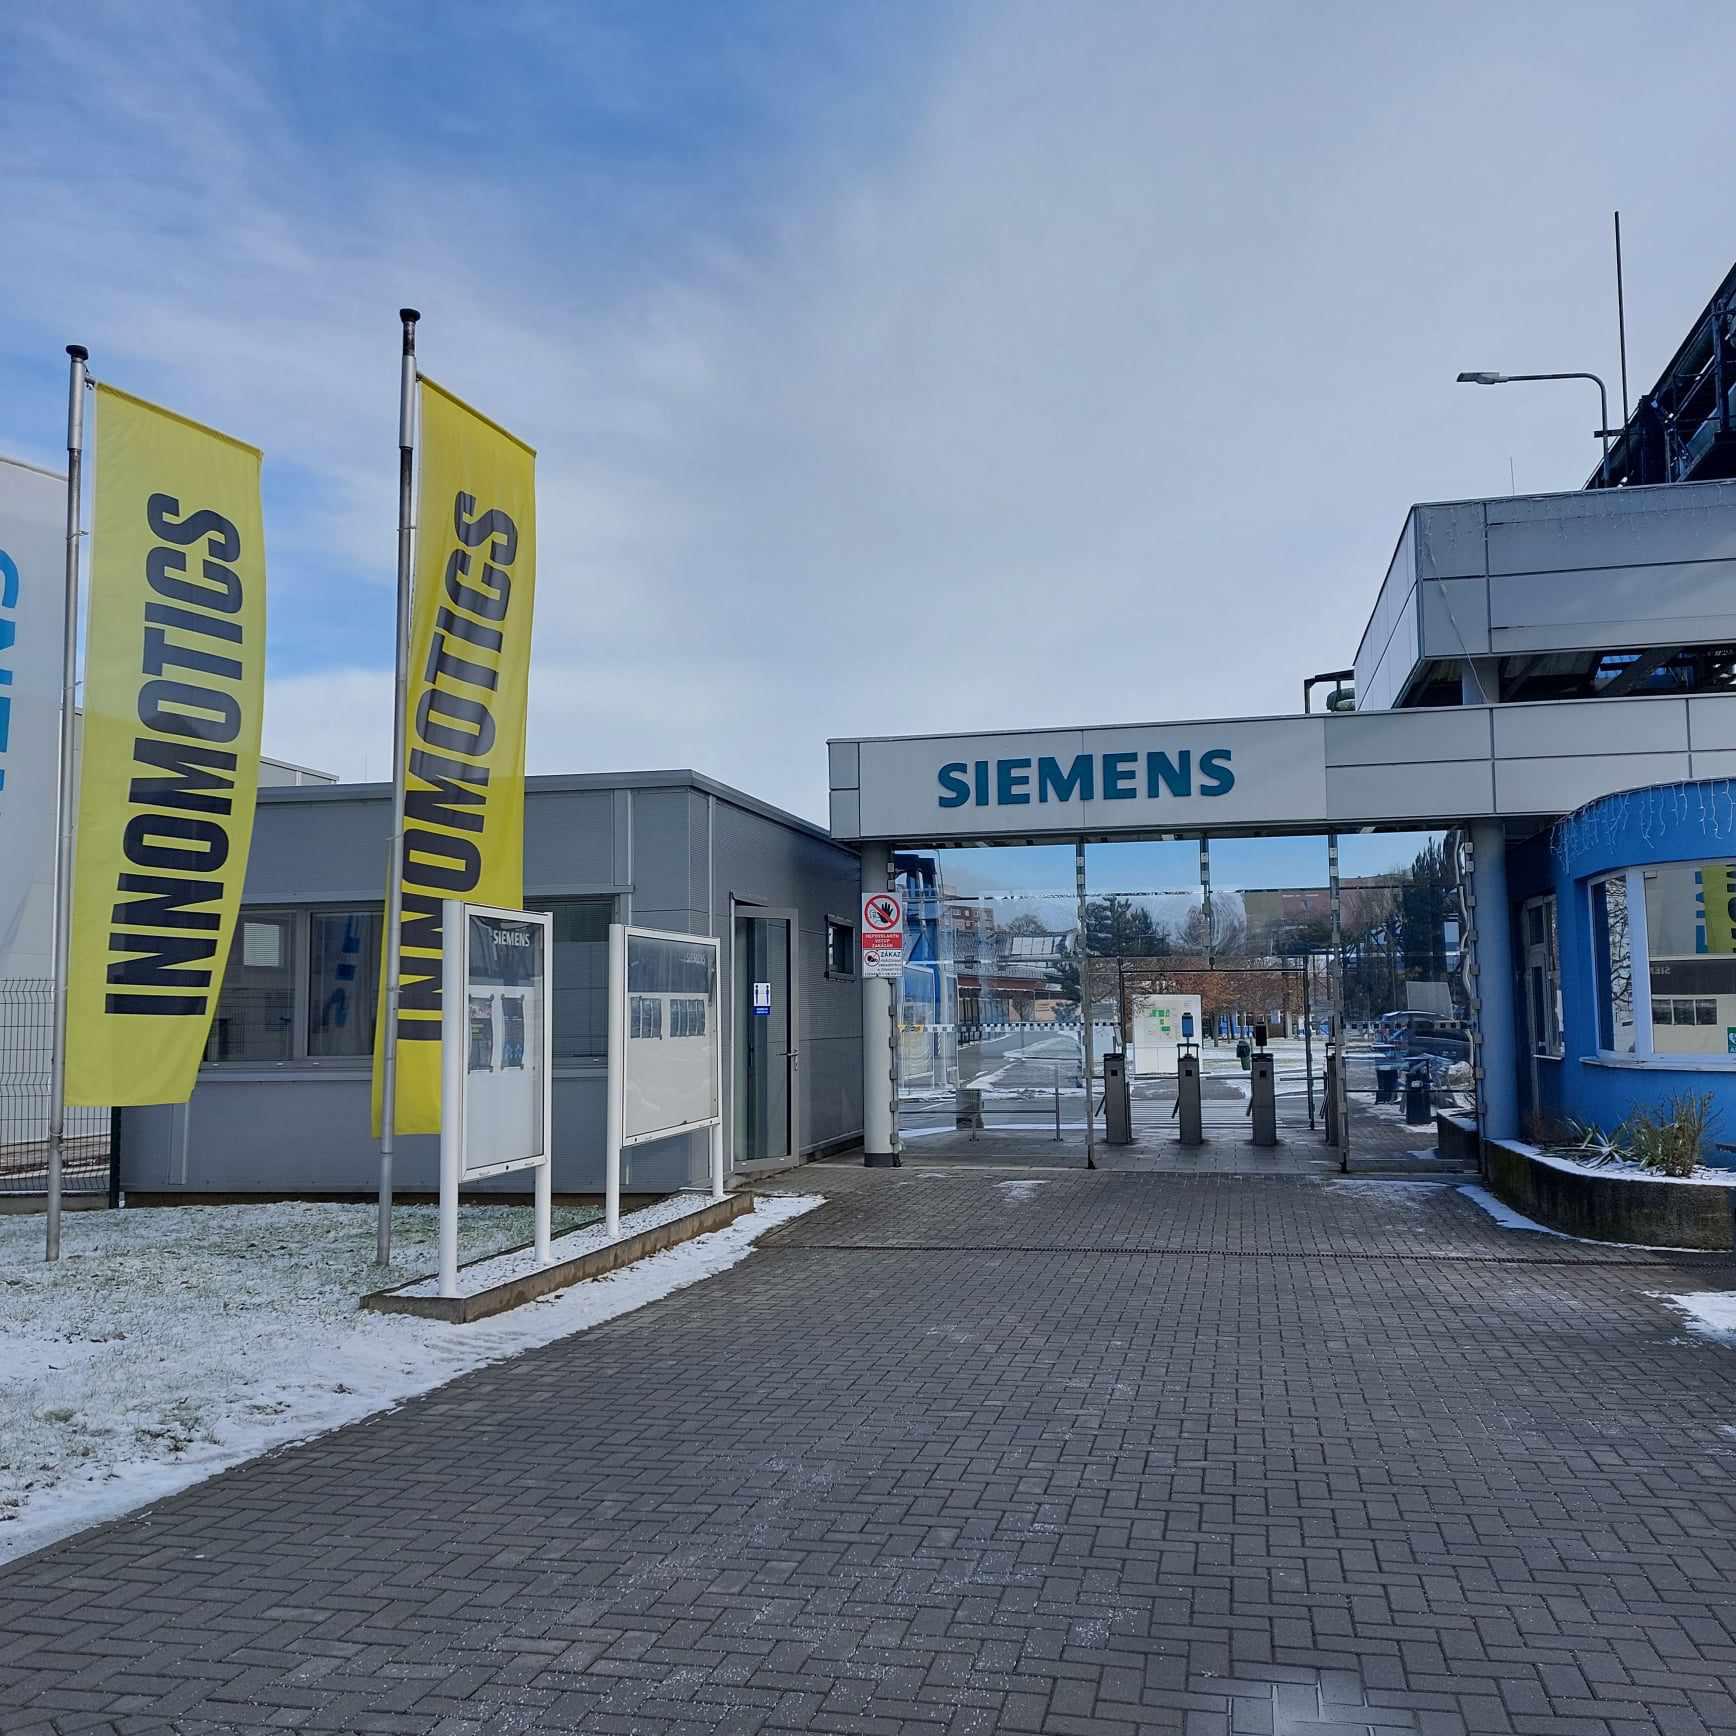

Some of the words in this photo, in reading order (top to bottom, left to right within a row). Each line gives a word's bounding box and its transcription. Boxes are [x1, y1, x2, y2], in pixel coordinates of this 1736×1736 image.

[105, 493, 242, 1016] INNOMOTICS
[938, 749, 1235, 807] SIEMENS
[493, 929, 530, 947] SIEMENS
